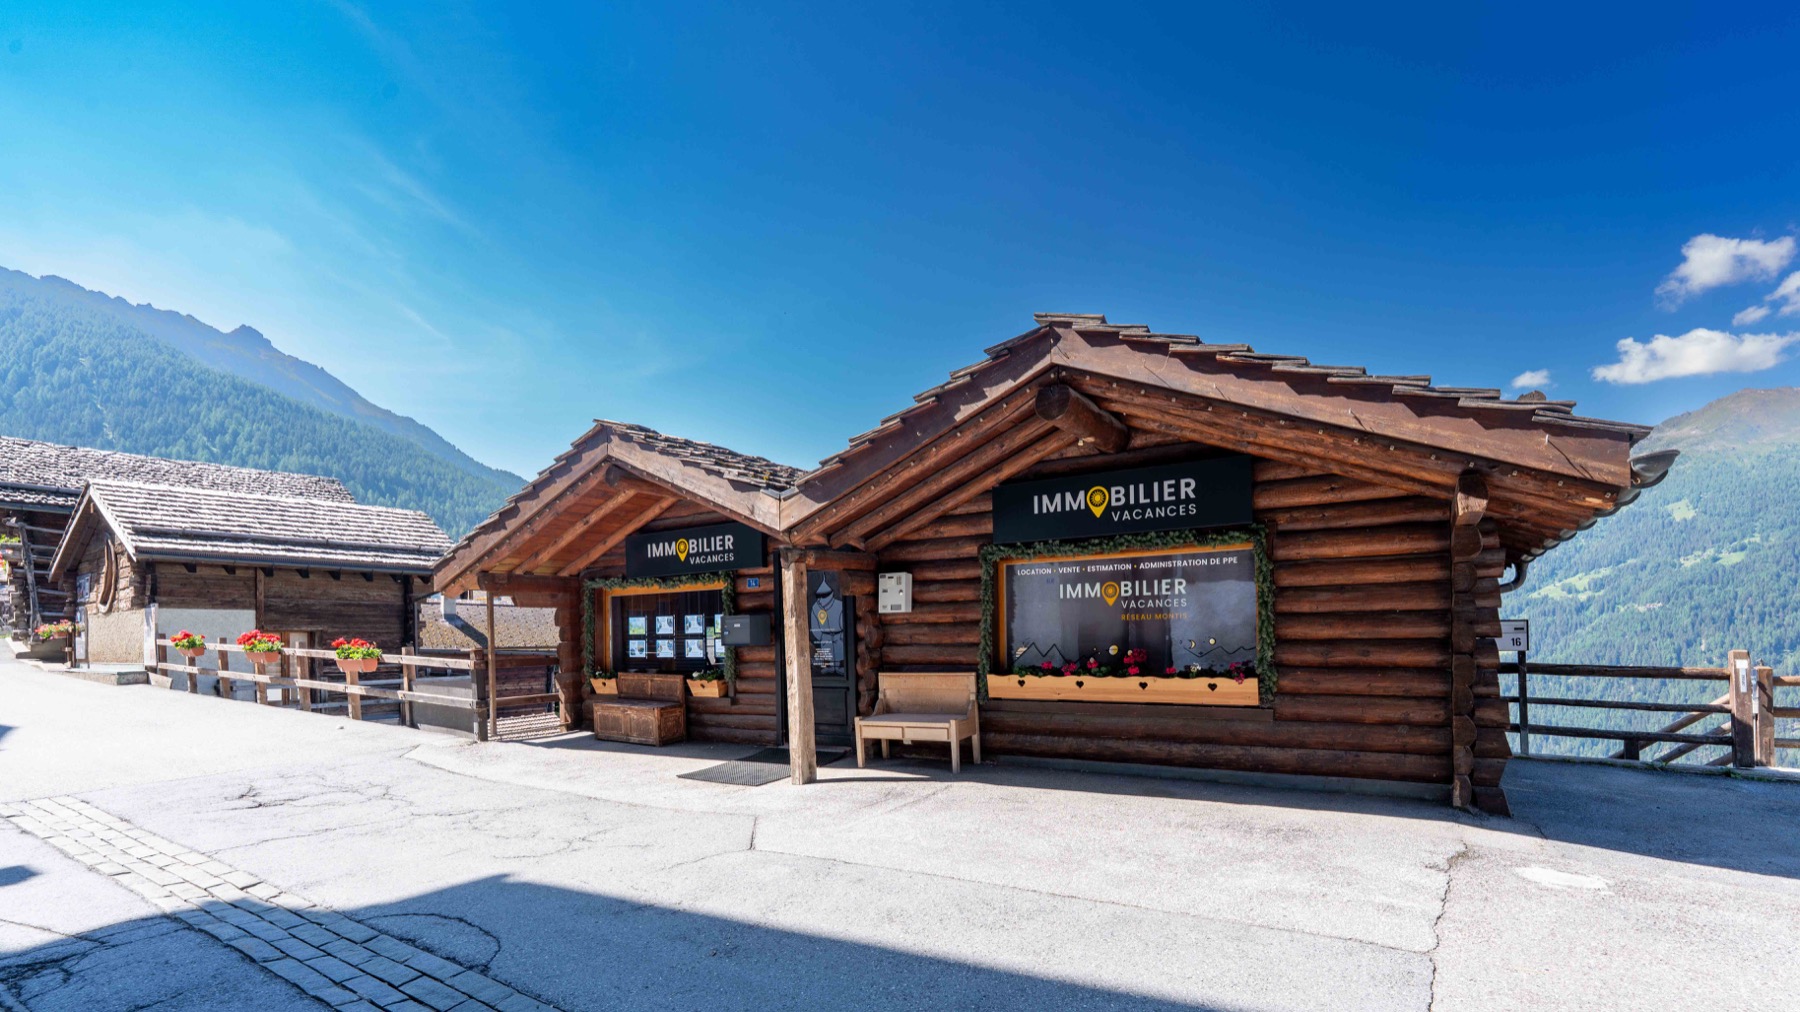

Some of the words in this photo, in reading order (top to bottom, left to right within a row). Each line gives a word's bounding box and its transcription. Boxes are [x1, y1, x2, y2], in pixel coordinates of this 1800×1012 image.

[1033, 477, 1197, 518] IMMOBILIER
[1111, 503, 1197, 522] VACANCES
[647, 535, 734, 562] IMMOBILIER
[689, 552, 735, 565] VACANCES
[1017, 567, 1052, 576] LOCATION
[1058, 565, 1081, 574] VENTE
[1087, 562, 1132, 573] ESTIMATION
[1139, 558, 1208, 570] ADMINISTRATION
[1210, 557, 1221, 566] DE
[1222, 556, 1238, 565] PPE
[1059, 578, 1187, 606] IMMOBILIER
[1121, 598, 1187, 609] VACANCES
[1511, 637, 1521, 647] 16
